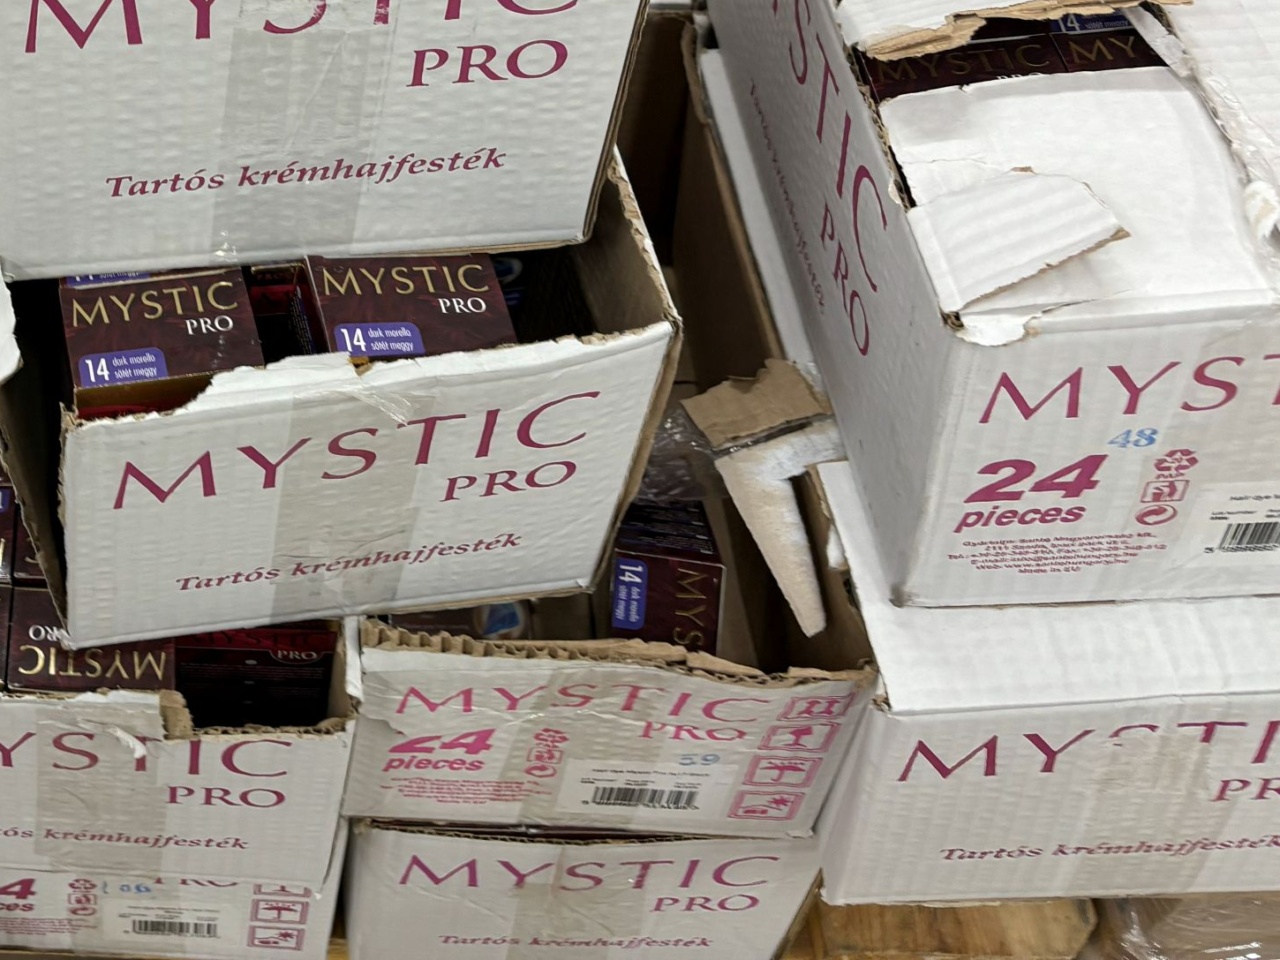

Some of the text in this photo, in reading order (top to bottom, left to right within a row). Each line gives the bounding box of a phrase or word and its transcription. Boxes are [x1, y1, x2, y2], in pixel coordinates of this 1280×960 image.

[406, 39, 569, 88] PRO
[106, 147, 507, 199] Tartós krémhajfesték
[322, 263, 490, 296] MYSTIC
[820, 201, 870, 357] PRO
[72, 280, 239, 328] MYSTIC
[437, 296, 487, 314] PRO
[185, 314, 235, 336] PRO
[339, 326, 412, 353] 14 dark morello
[84, 352, 157, 383] 14 dark morello
[112, 390, 600, 511] MYSTIC
[1107, 427, 1160, 449] 48
[438, 460, 578, 503] PRO
[963, 453, 1110, 504] 24
[952, 504, 1088, 534] pieces
[175, 532, 524, 592] Tartós krémhajfesték
[395, 683, 772, 724] MYSTIC
[638, 720, 748, 742] PRO
[381, 754, 485, 773] pieces
[166, 785, 287, 809] PRO
[43, 825, 250, 850] krémhajfesték
[939, 846, 1043, 861] Tartós
[398, 854, 781, 892] MYSTIC
[649, 894, 761, 913] PRO
[437, 934, 714, 949] Tartós krémhajfesték
